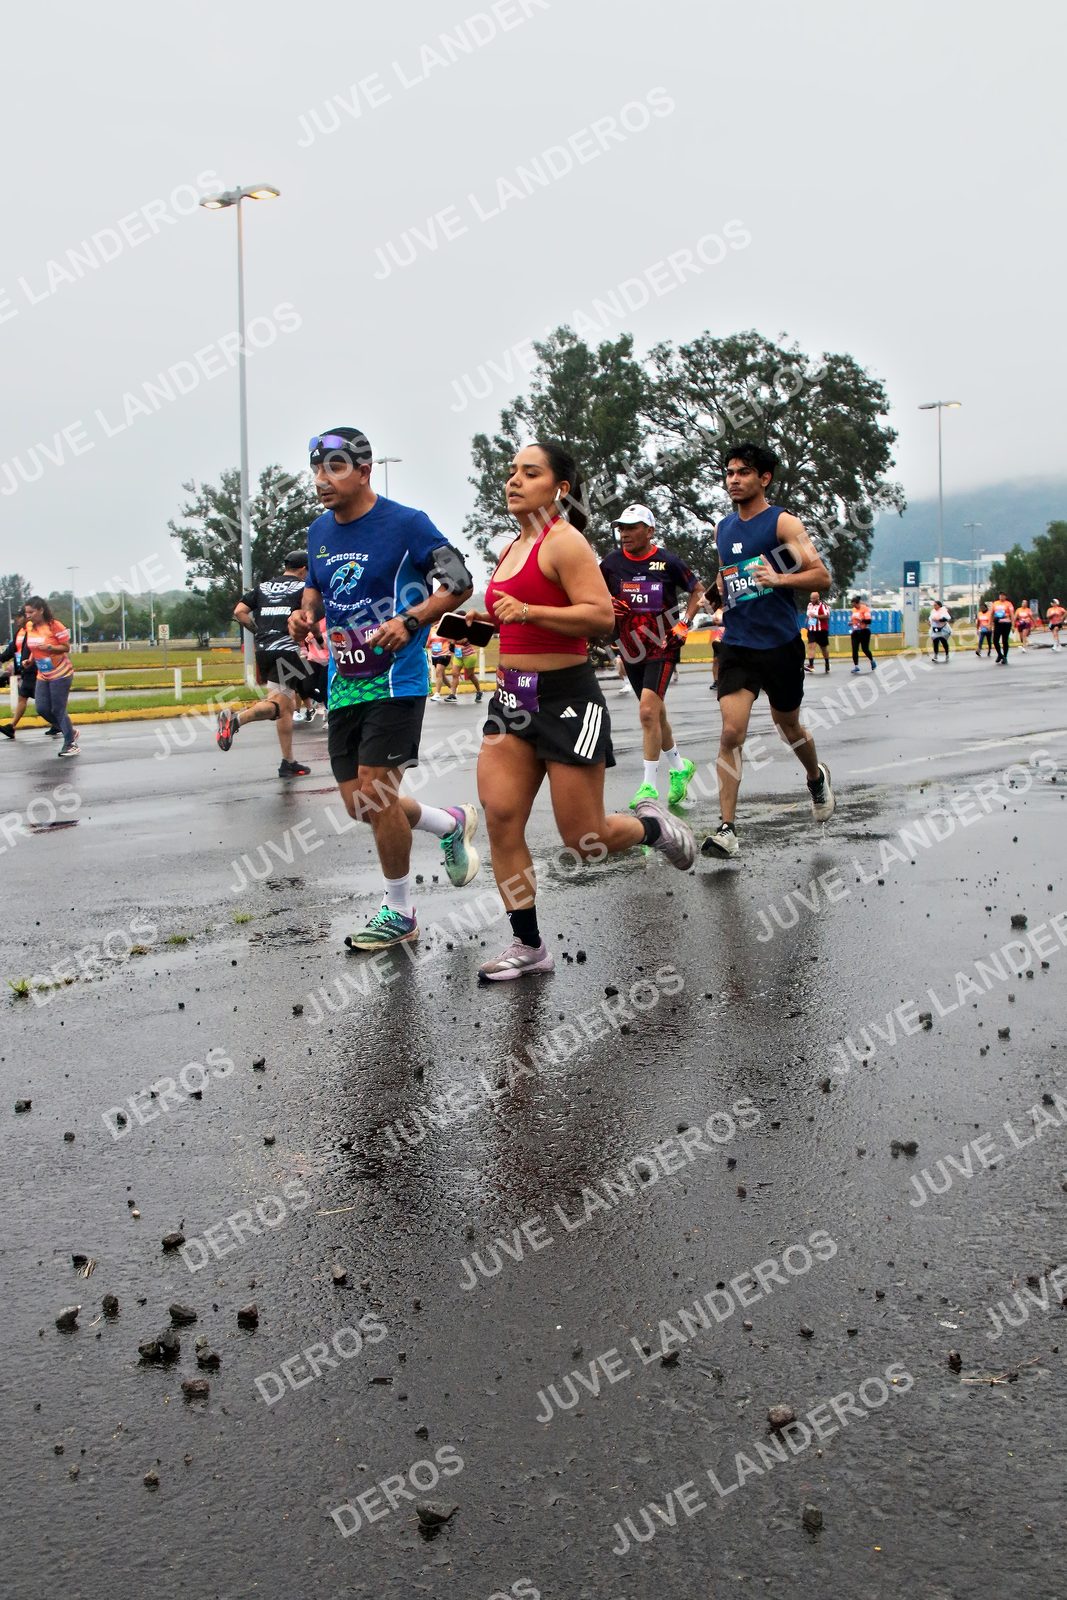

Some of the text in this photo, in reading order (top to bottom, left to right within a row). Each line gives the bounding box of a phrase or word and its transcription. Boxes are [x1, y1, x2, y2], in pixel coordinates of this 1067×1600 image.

[648, 561, 666, 571] 21K
[729, 576, 756, 592] 1394
[906, 571, 916, 585] E
[630, 593, 649, 604] 761
[337, 649, 366, 665] 210
[498, 688, 517, 709] 238
